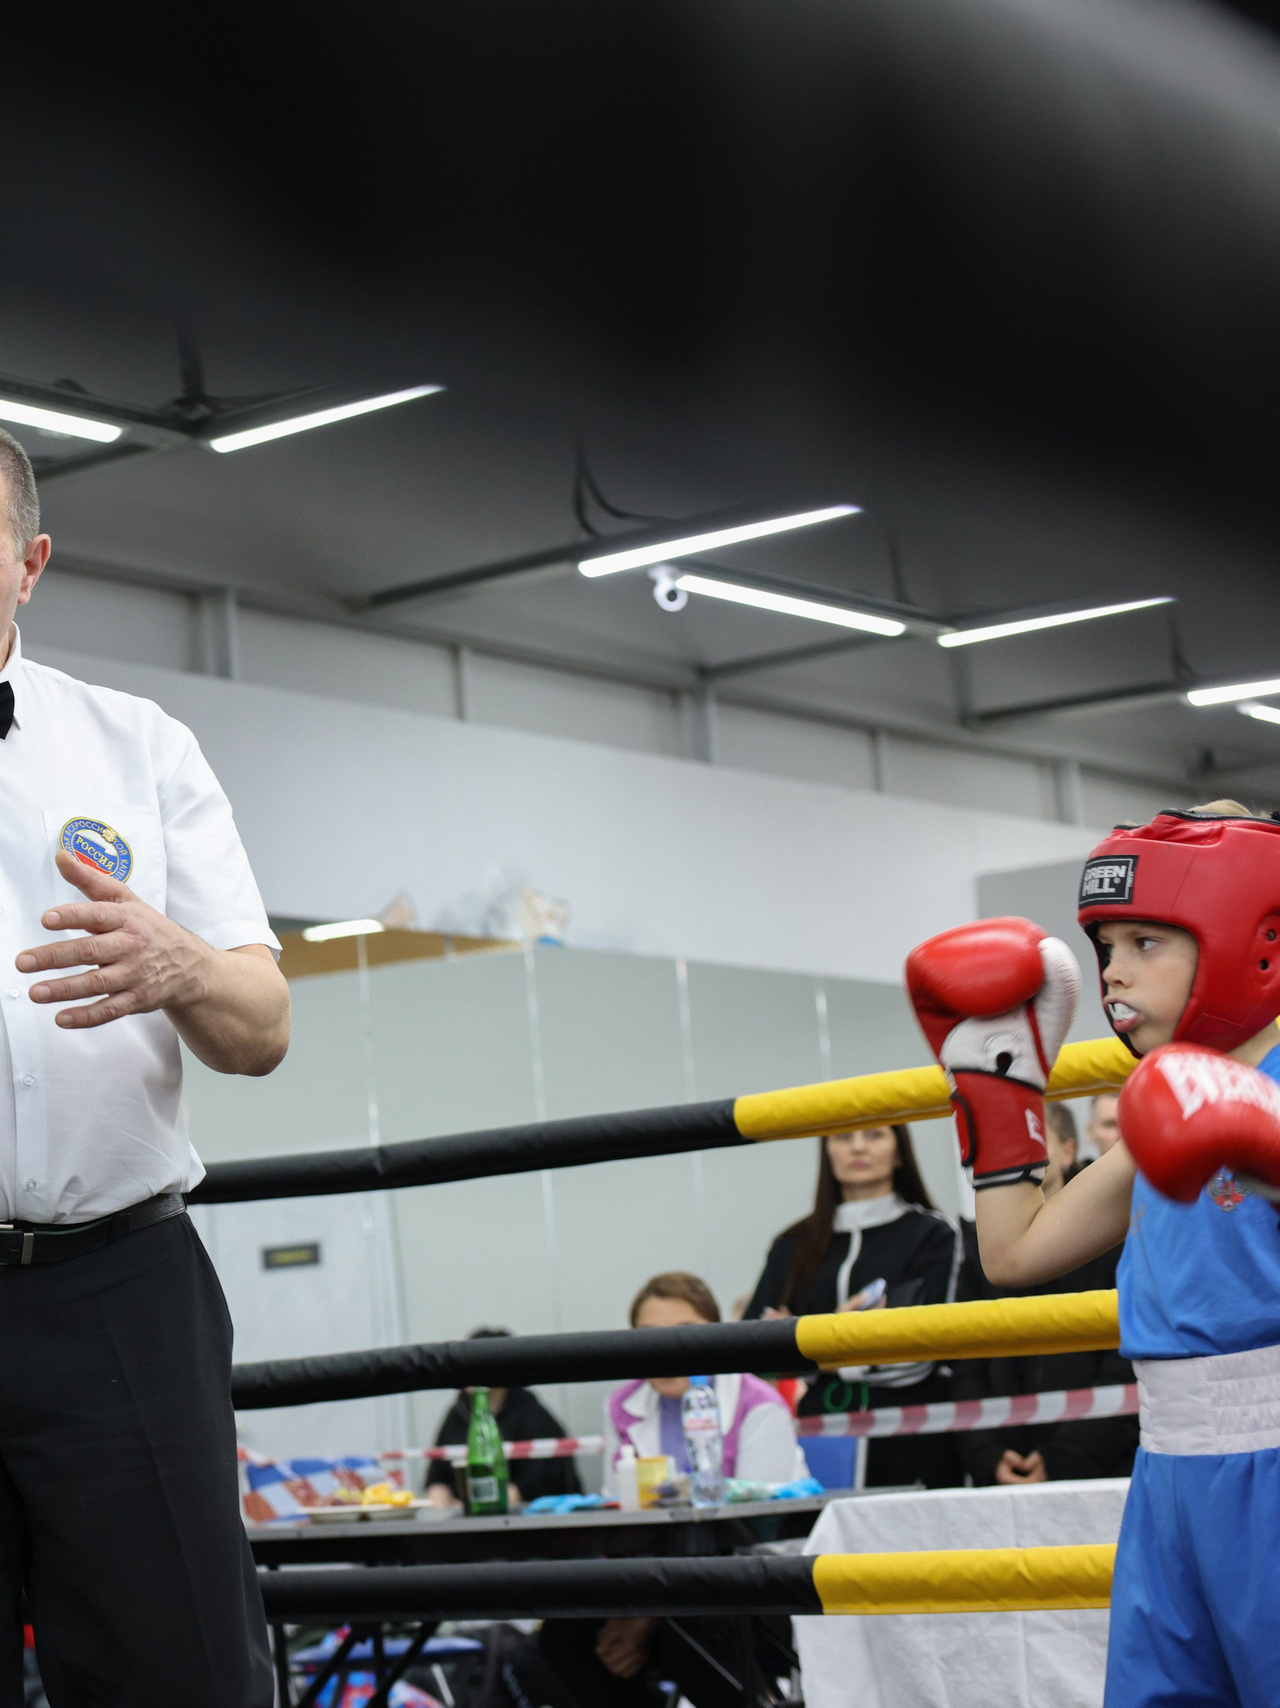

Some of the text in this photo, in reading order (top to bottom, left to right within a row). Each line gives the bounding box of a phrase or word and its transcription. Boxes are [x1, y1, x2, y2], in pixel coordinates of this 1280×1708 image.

[65, 820, 128, 856] ВСЕРОССИОЙ
[76, 836, 115, 871] РОССИЯ
[1084, 865, 1127, 882] GREEN
